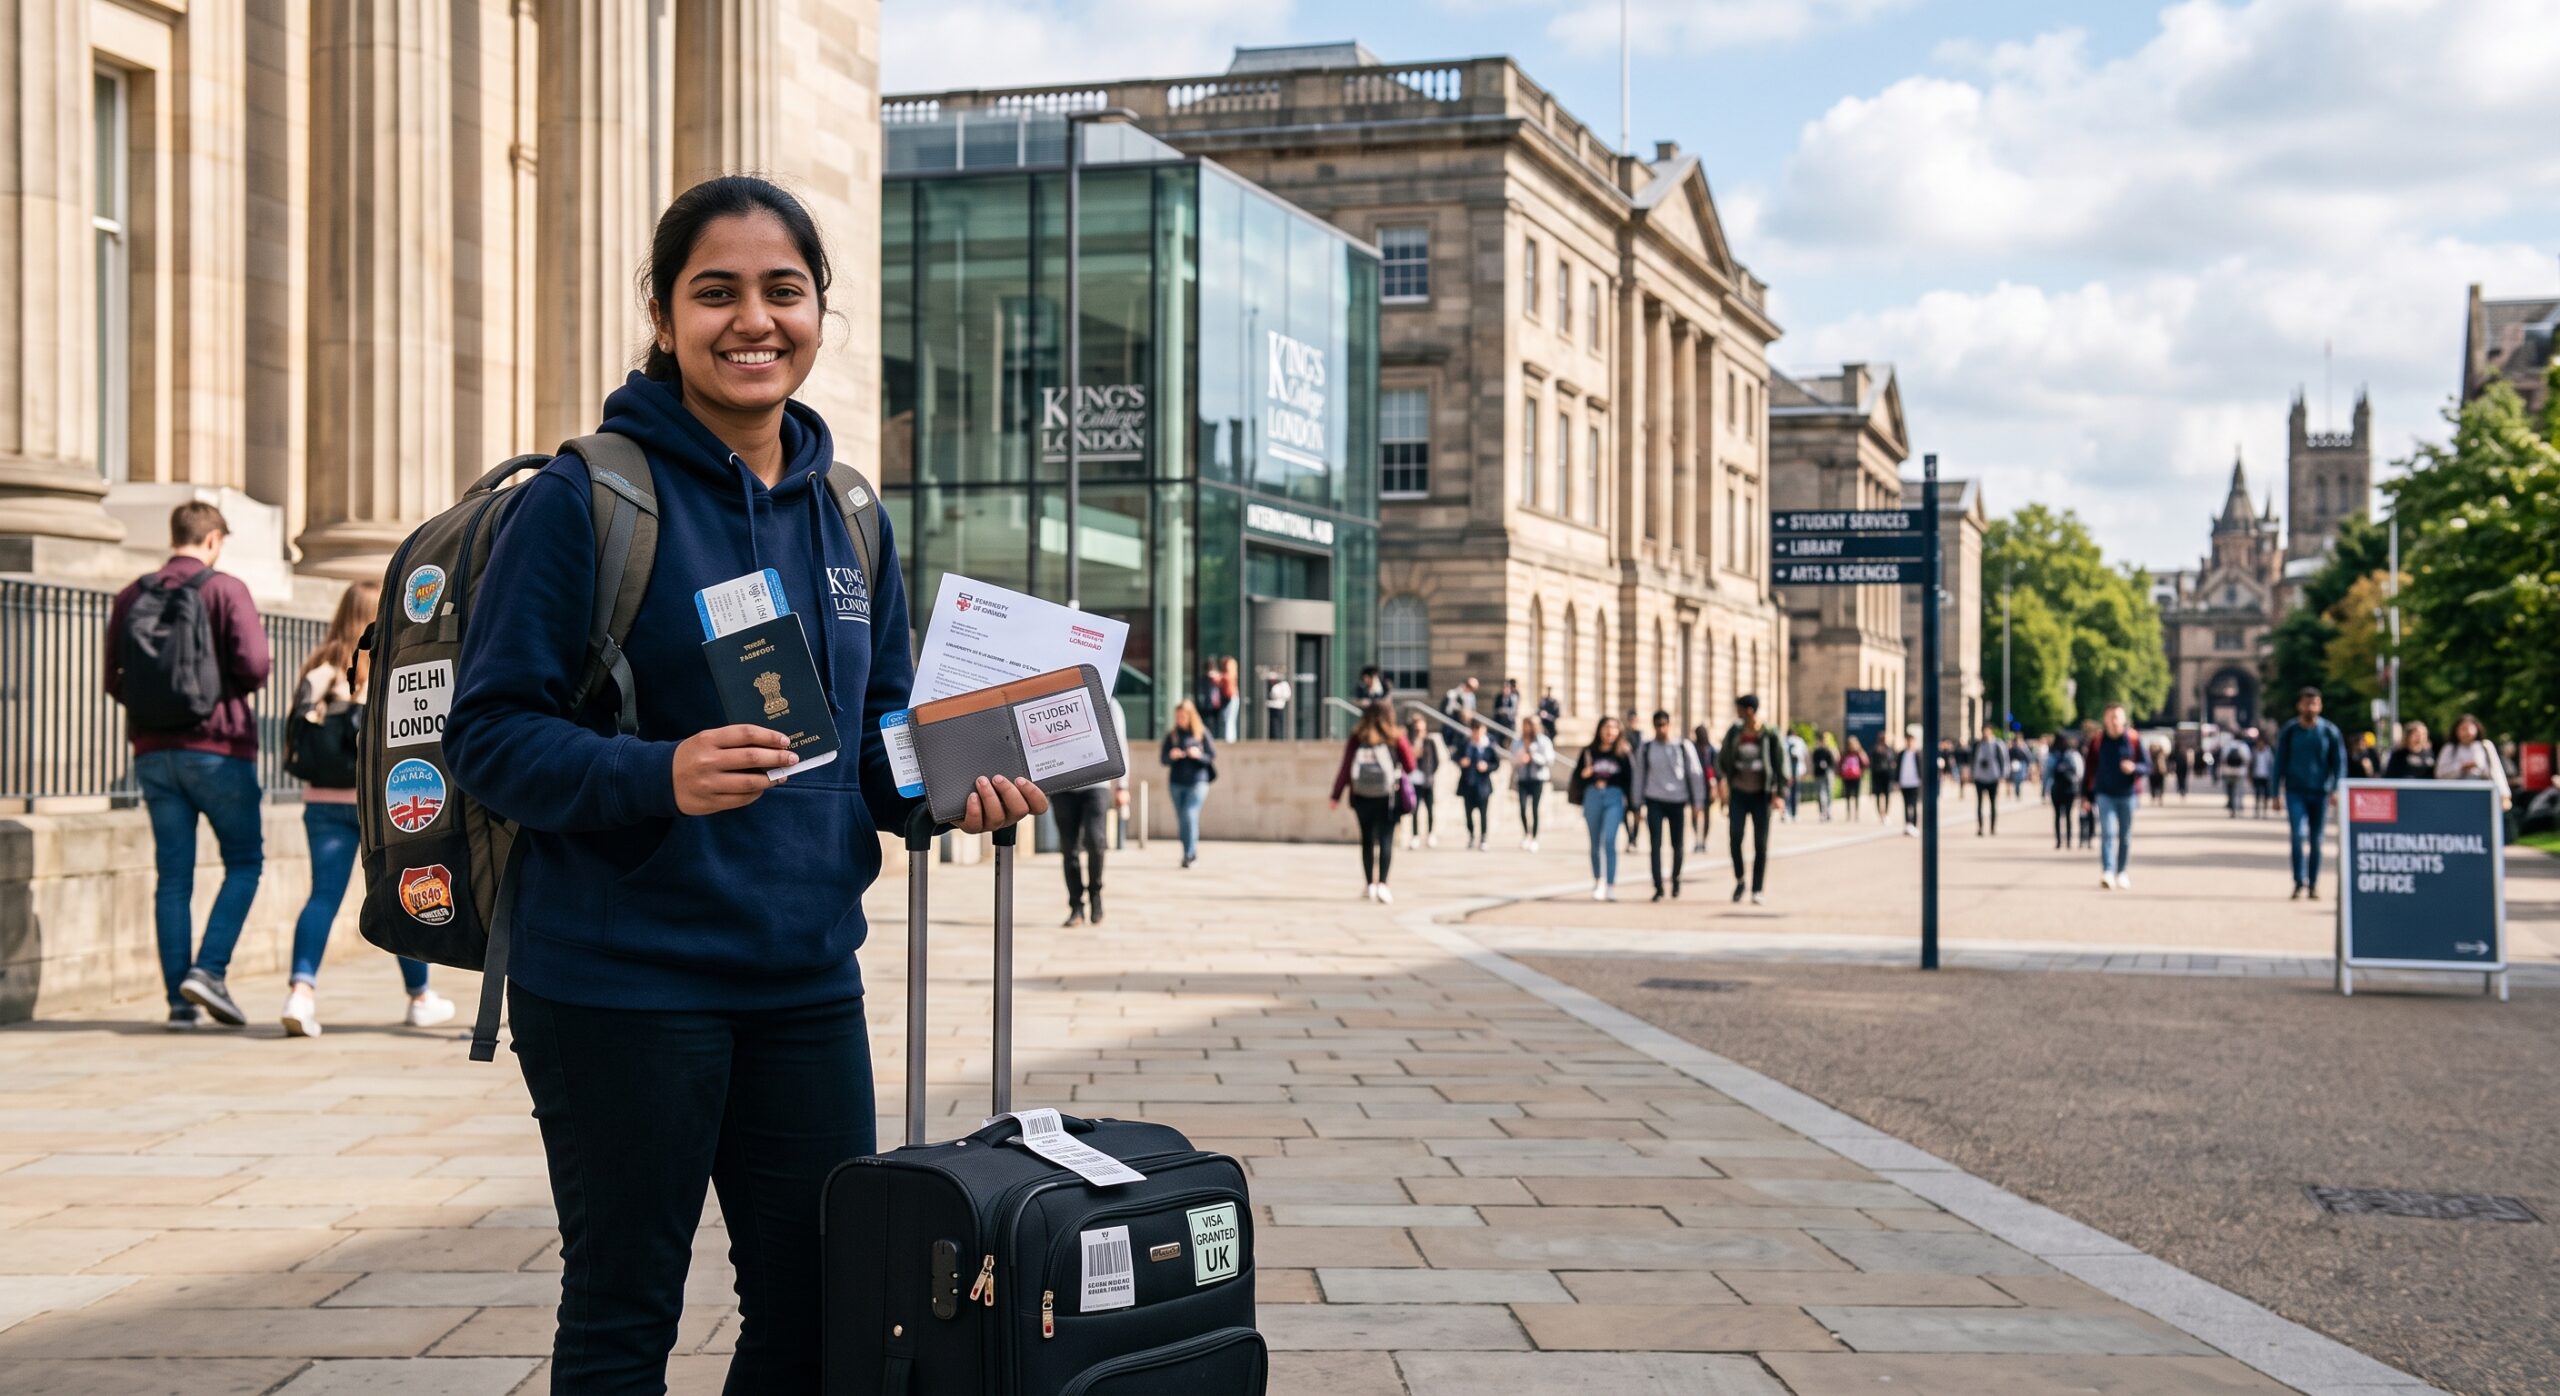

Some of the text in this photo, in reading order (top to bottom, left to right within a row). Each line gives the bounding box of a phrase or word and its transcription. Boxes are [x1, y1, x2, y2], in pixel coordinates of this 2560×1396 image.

[1267, 405, 1325, 450] LONDON
[1790, 513, 1910, 530] STUDENT SERVICES
[1790, 540, 1844, 556] LIBRARY
[1790, 565, 1900, 582] ARTS & SCIENCES
[398, 668, 446, 694] DELHI
[414, 697, 428, 711] to
[1029, 702, 1079, 724] STUDENT
[391, 714, 447, 739] LONDO
[1045, 719, 1072, 734] VISA
[2357, 833, 2487, 854] INTERNATIONAL
[2357, 853, 2445, 874] STUDENTS
[2357, 873, 2416, 893] OFFICE
[1202, 1214, 1224, 1228] VISA
[1195, 1228, 1236, 1246] GRANTED
[1205, 1245, 1231, 1272] UK
